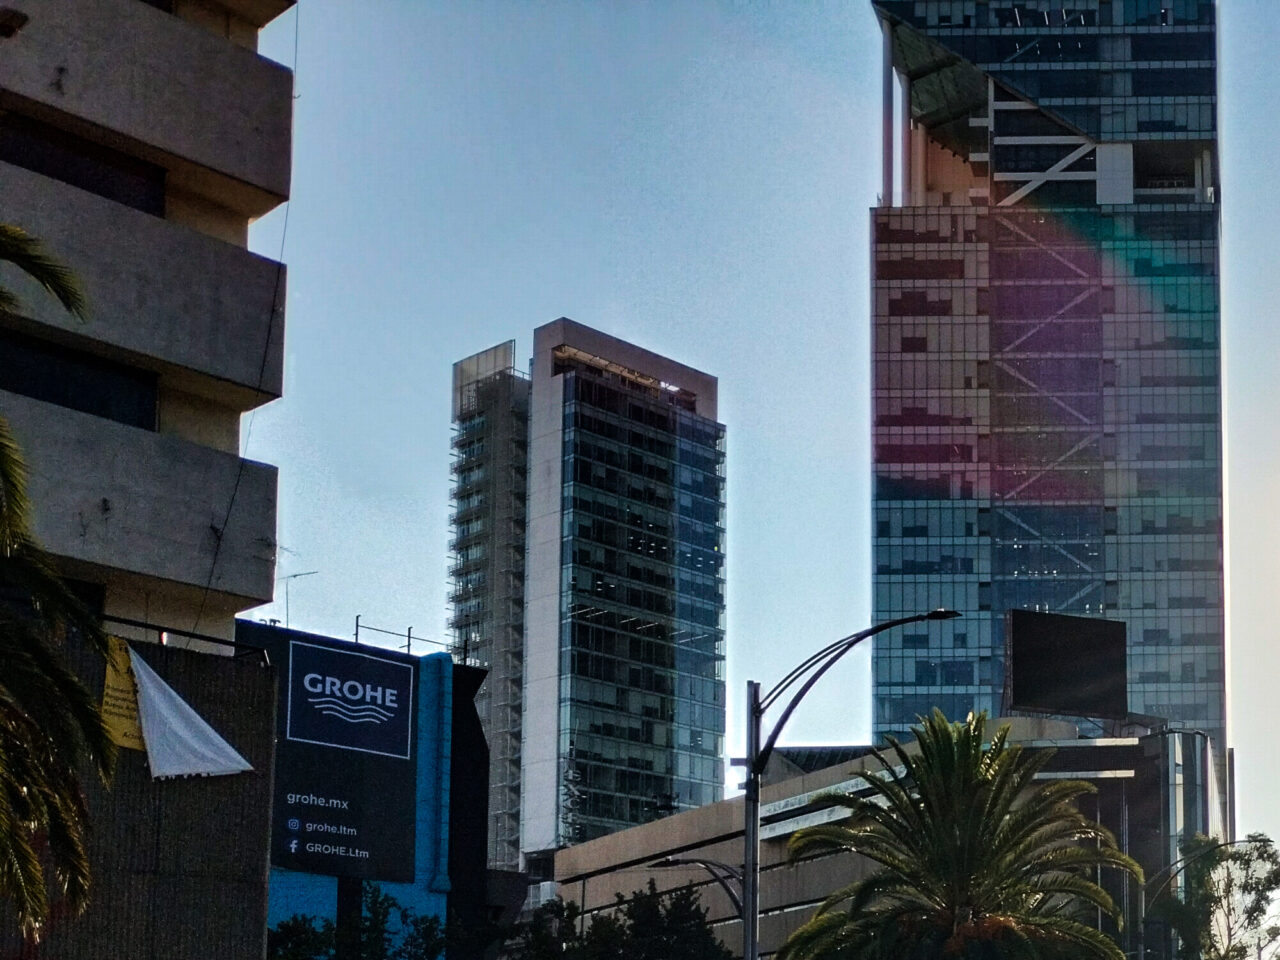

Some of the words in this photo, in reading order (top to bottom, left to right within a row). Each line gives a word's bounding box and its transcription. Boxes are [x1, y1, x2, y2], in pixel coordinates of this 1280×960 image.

[303, 673, 398, 708] GROHE
[287, 793, 349, 810] grohe.mx
[305, 821, 357, 836] grohe.ltm
[306, 842, 369, 859] GROHE.Ltm
